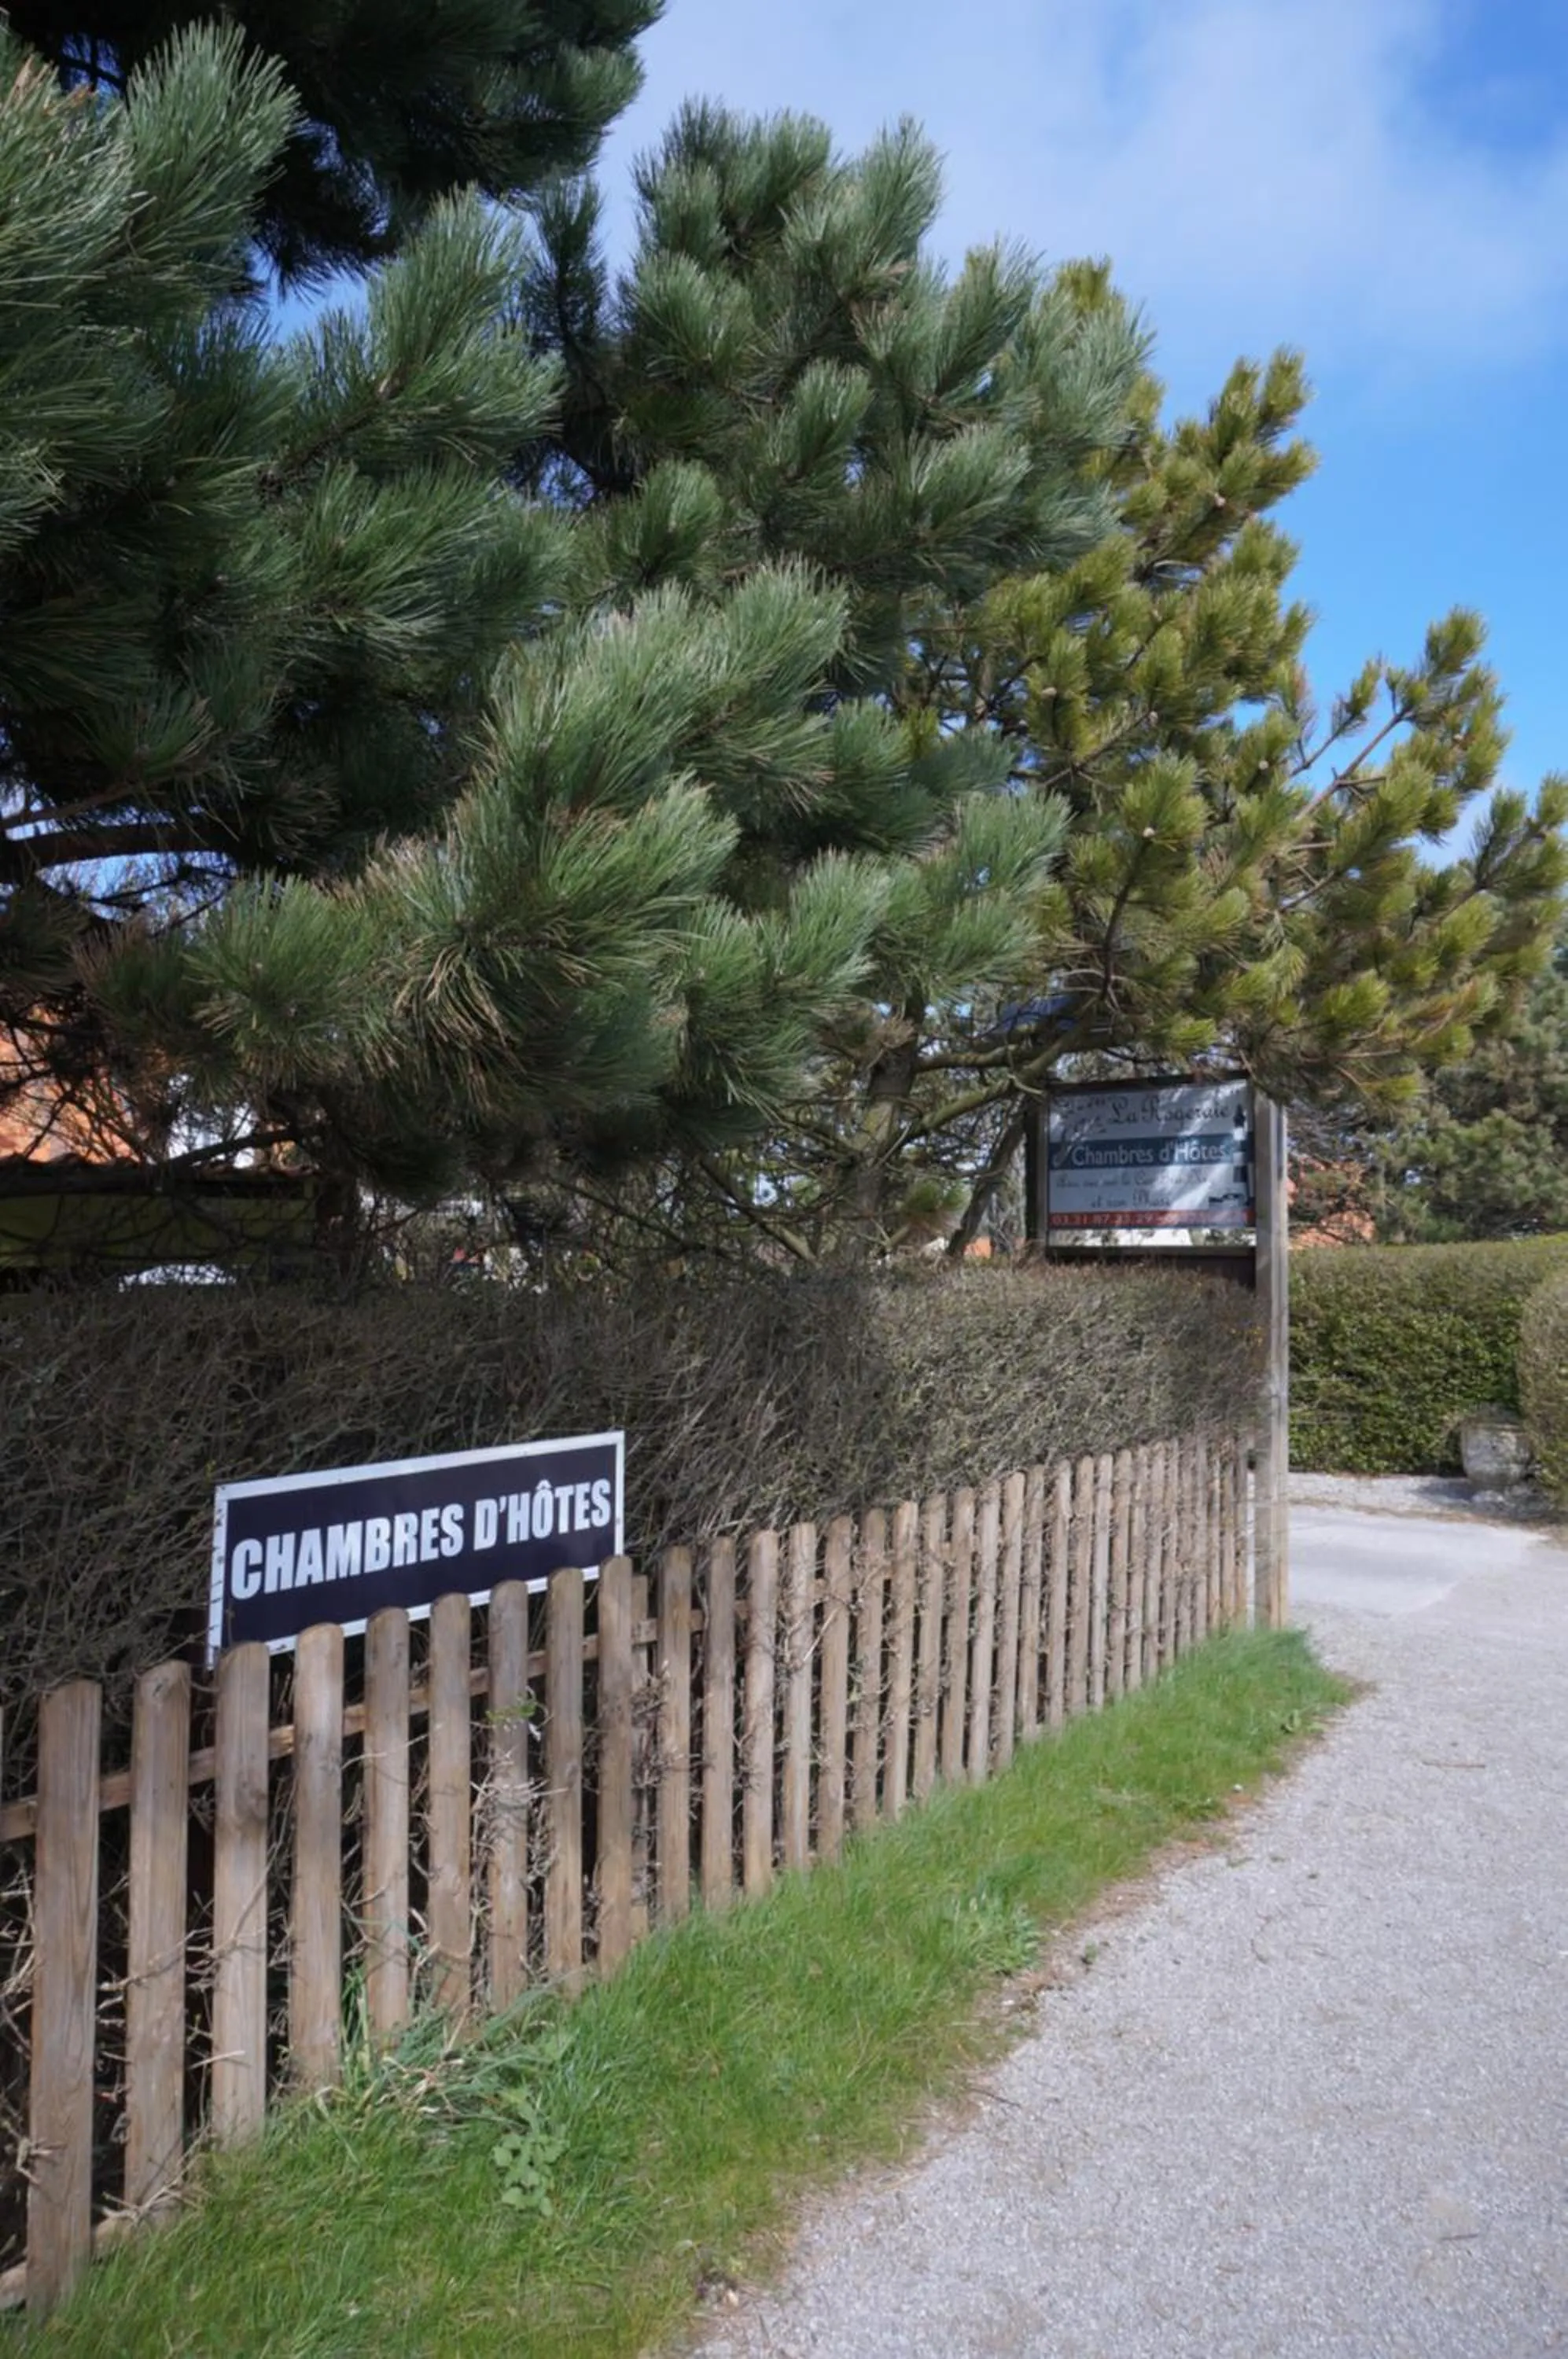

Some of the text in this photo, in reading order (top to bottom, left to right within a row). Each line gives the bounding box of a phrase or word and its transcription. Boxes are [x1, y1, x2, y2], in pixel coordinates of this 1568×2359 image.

[1071, 1139, 1227, 1166] Chambres d'Hôtes
[230, 1479, 613, 1600] CHAMBRES D'HÔTES
